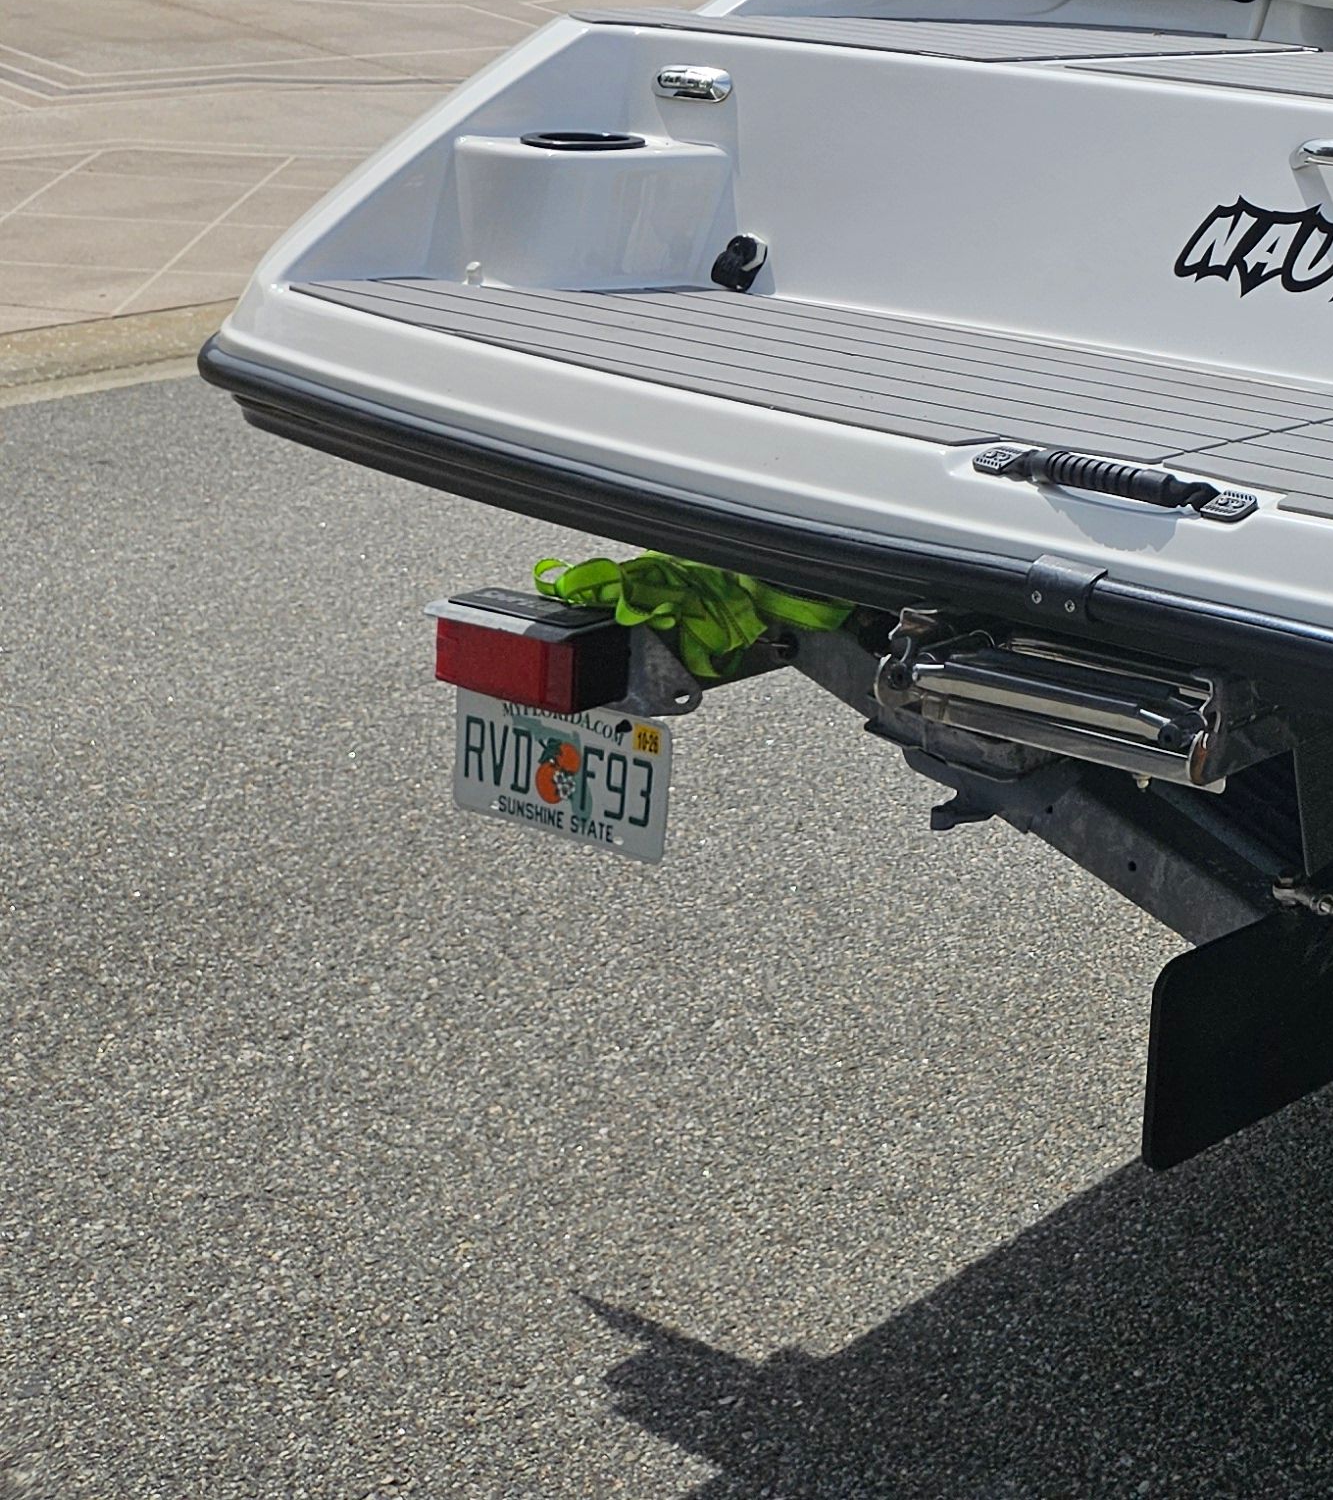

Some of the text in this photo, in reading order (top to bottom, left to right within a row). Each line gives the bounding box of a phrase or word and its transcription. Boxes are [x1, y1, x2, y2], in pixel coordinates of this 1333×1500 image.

[464, 715, 654, 828] RVD F93
[498, 795, 614, 844] SUNSHINE STATE
